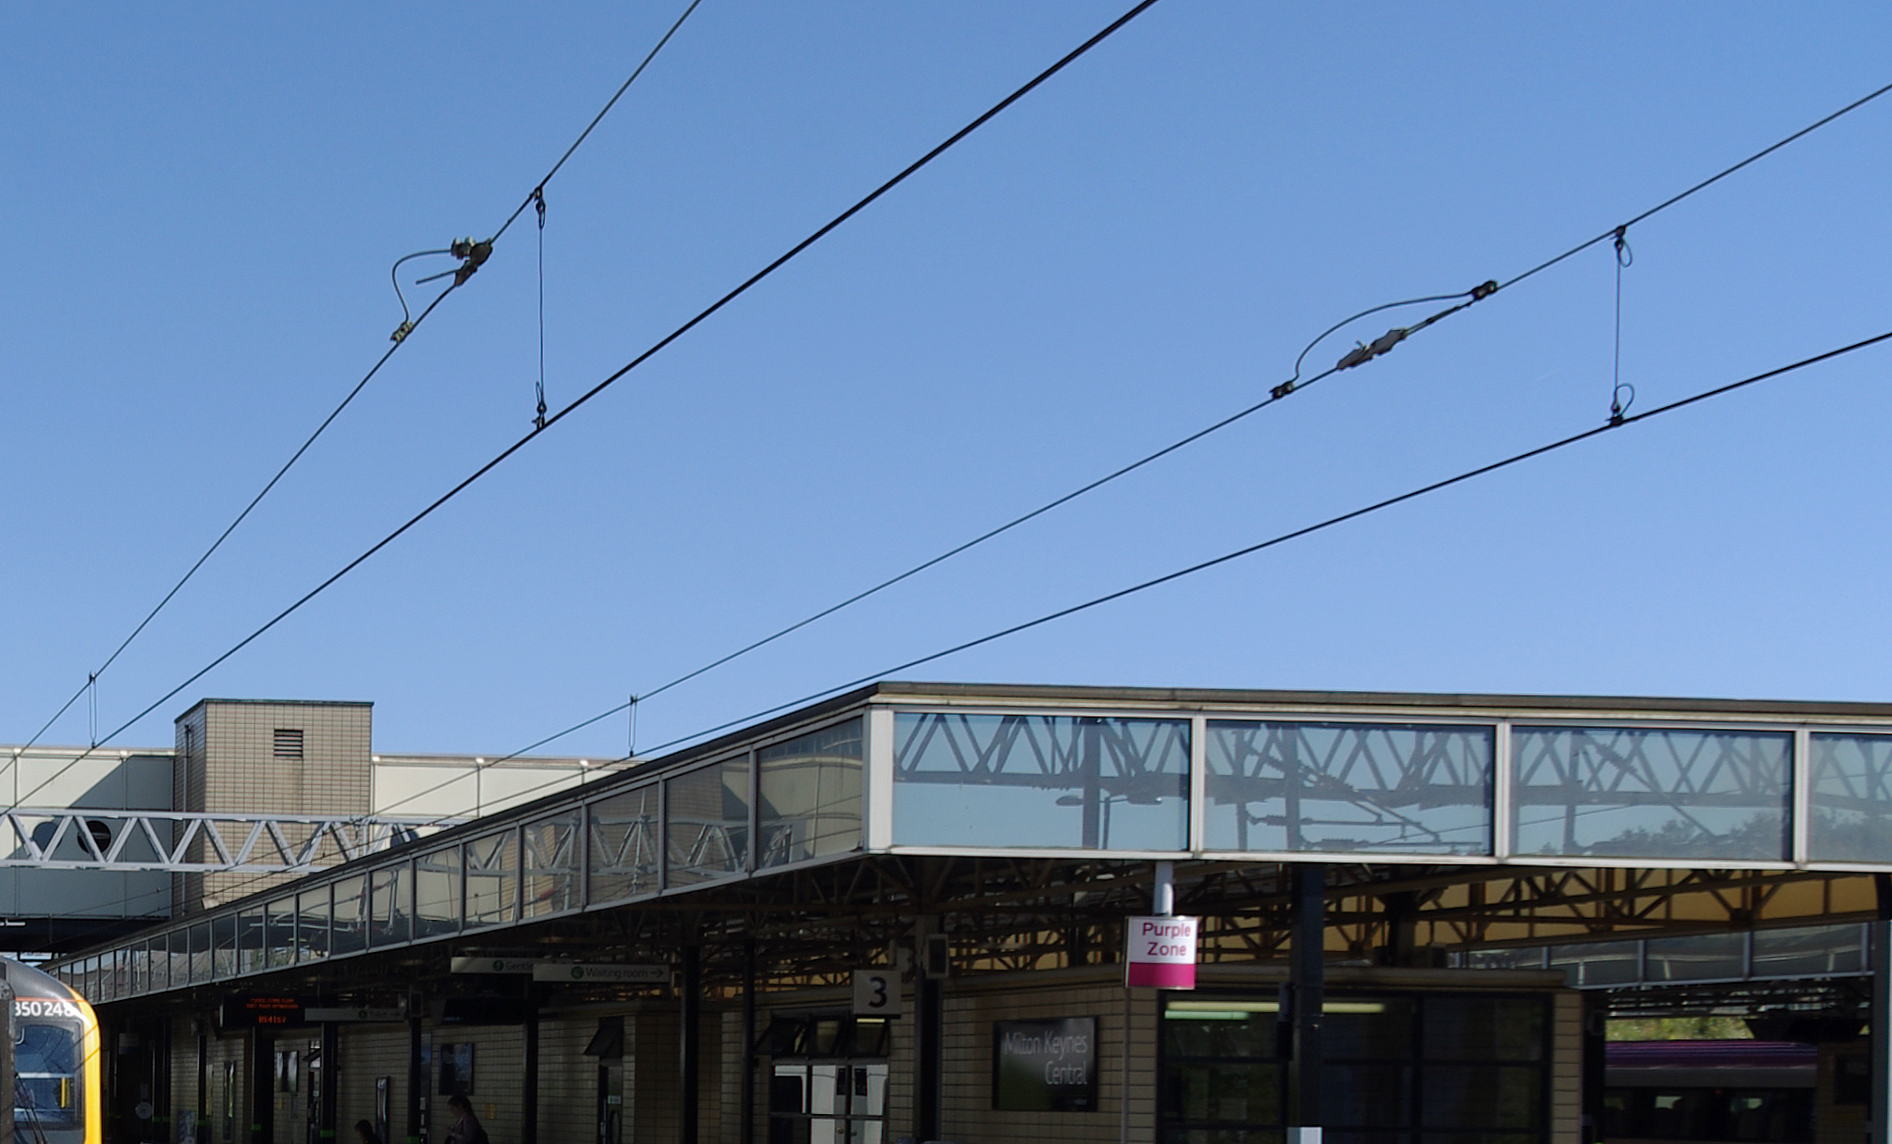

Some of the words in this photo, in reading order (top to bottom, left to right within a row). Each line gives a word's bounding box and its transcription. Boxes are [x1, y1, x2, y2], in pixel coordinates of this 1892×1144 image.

[1142, 922, 1191, 939] Purple
[1147, 941, 1187, 956] Zone
[585, 967, 622, 980] Waiting
[623, 969, 648, 978] room
[868, 976, 888, 1008] 3
[1004, 1031, 1041, 1055] Milton
[1044, 1030, 1088, 1061] Keynes
[1045, 1060, 1088, 1086] Central
